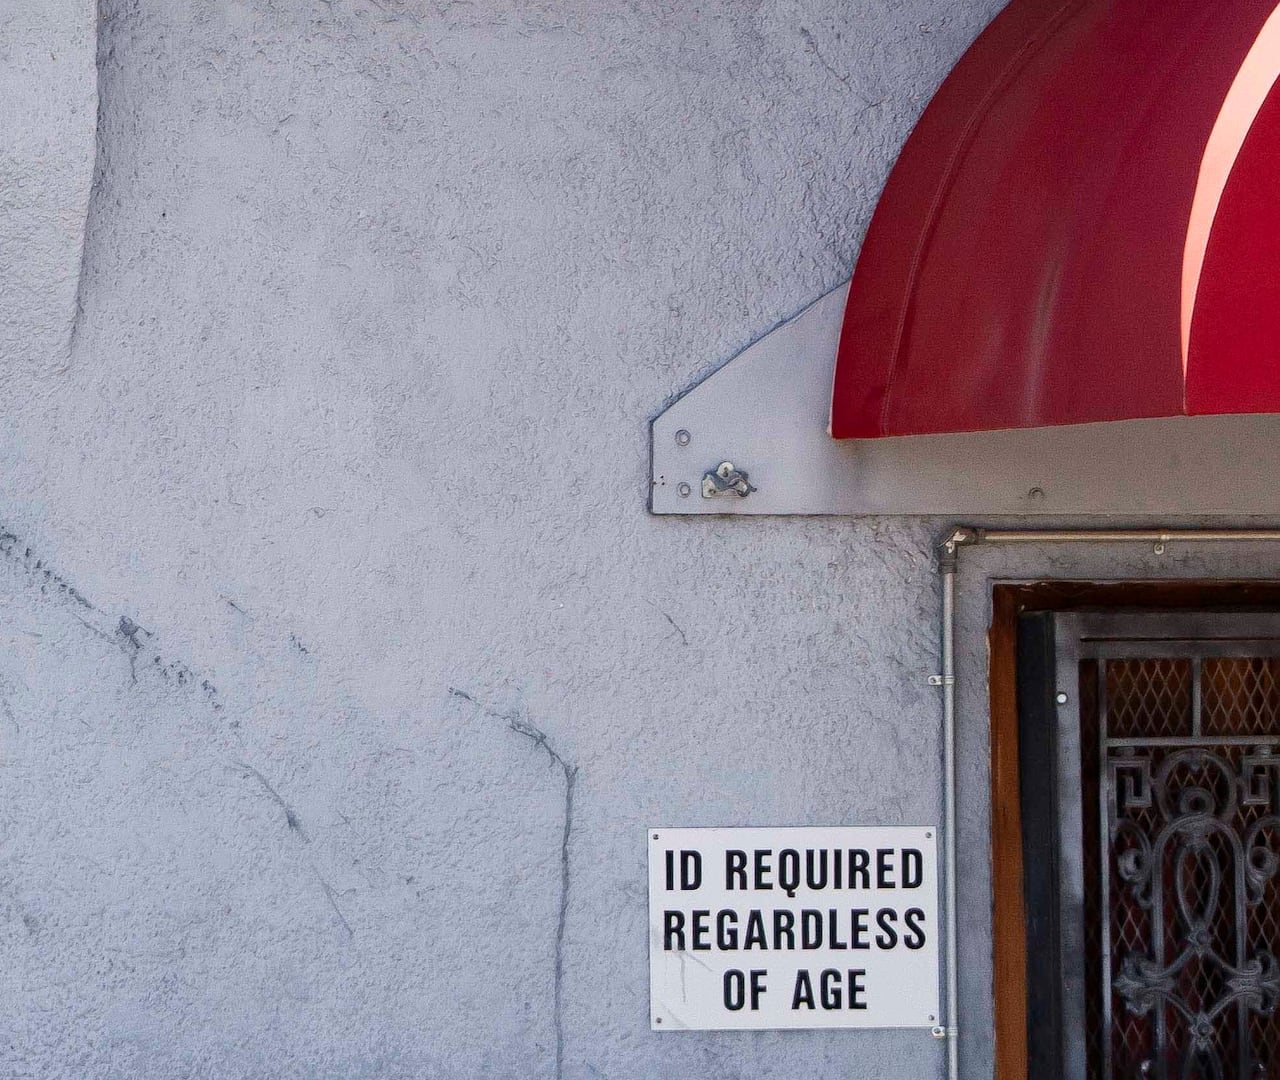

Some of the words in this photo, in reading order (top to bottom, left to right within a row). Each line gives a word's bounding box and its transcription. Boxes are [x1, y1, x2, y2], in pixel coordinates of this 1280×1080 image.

[664, 849, 703, 891] ID
[725, 848, 924, 898] REQUIRED
[663, 907, 926, 951] REGARDLESS
[723, 968, 768, 1011] OF
[791, 968, 868, 1010] AGE
